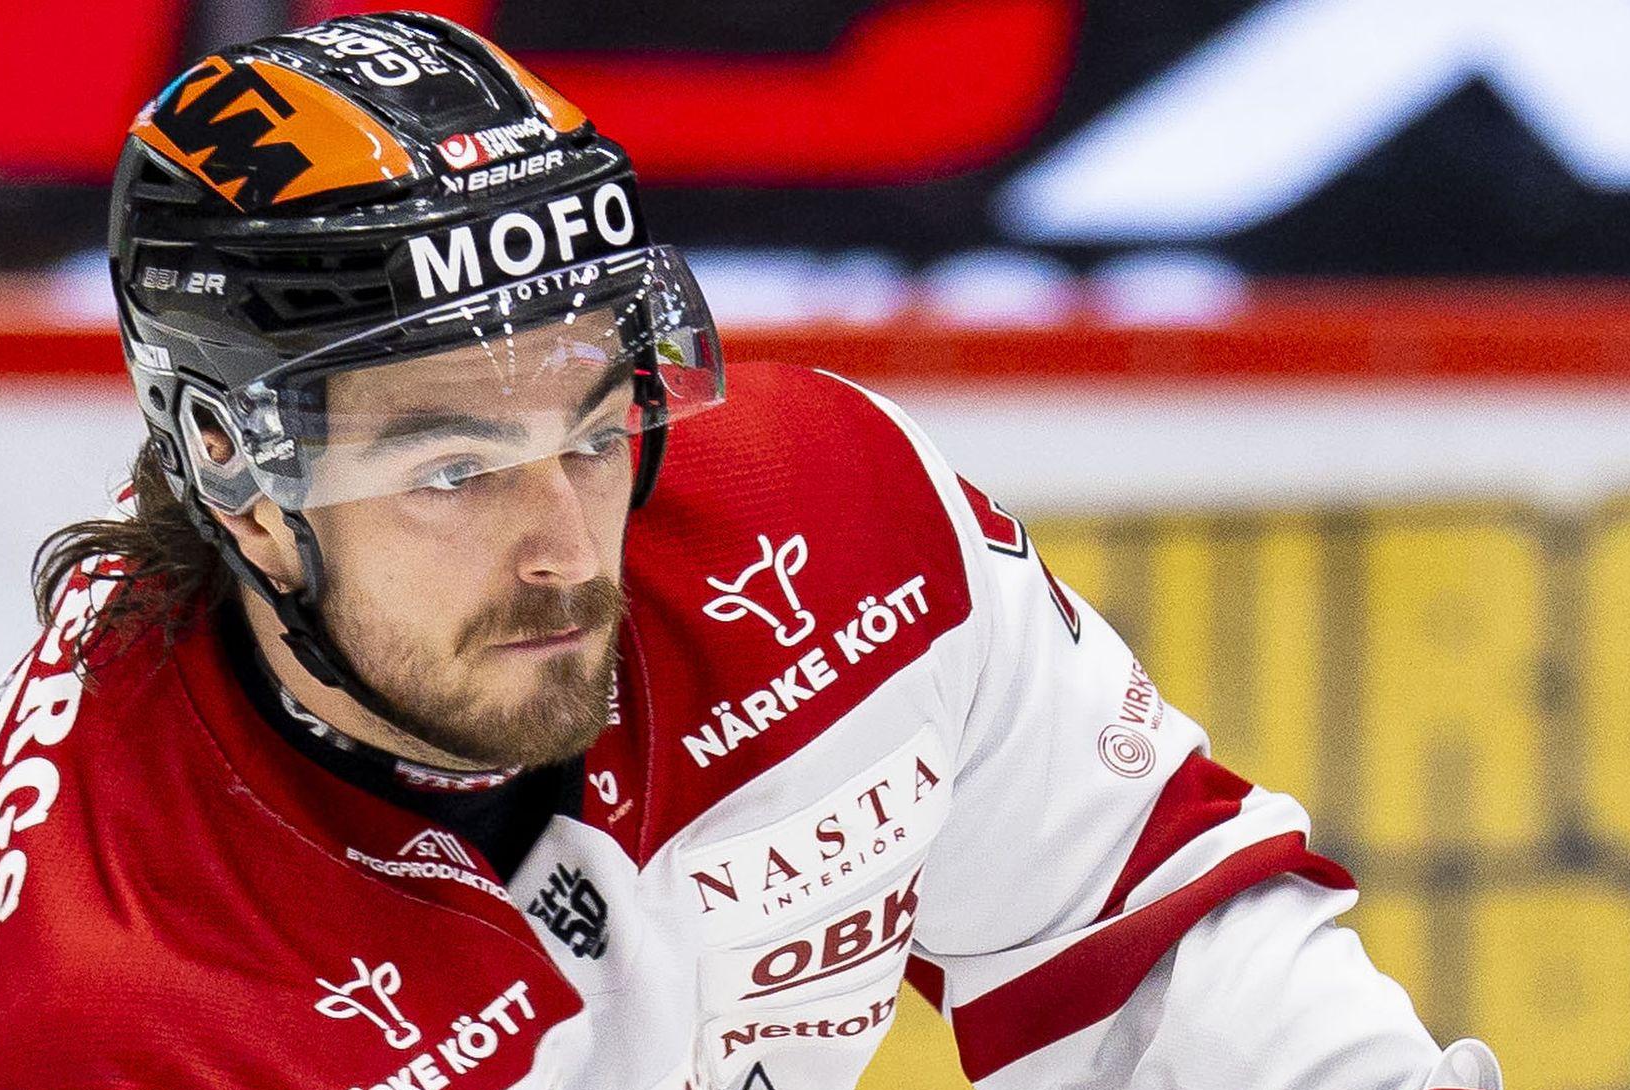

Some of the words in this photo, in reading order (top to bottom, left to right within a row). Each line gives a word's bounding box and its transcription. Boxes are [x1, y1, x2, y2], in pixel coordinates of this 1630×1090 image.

[467, 150, 564, 191] BAUER
[408, 183, 634, 299] MOFO
[681, 647, 839, 768] NÄRKE
[833, 574, 929, 664] KÖTT
[346, 847, 513, 903] BYGGPRODUKTIO
[689, 756, 941, 914] NASTA
[763, 827, 906, 916] INTERIÖR
[751, 863, 925, 987] OBK
[436, 979, 536, 1075] KÖTT
